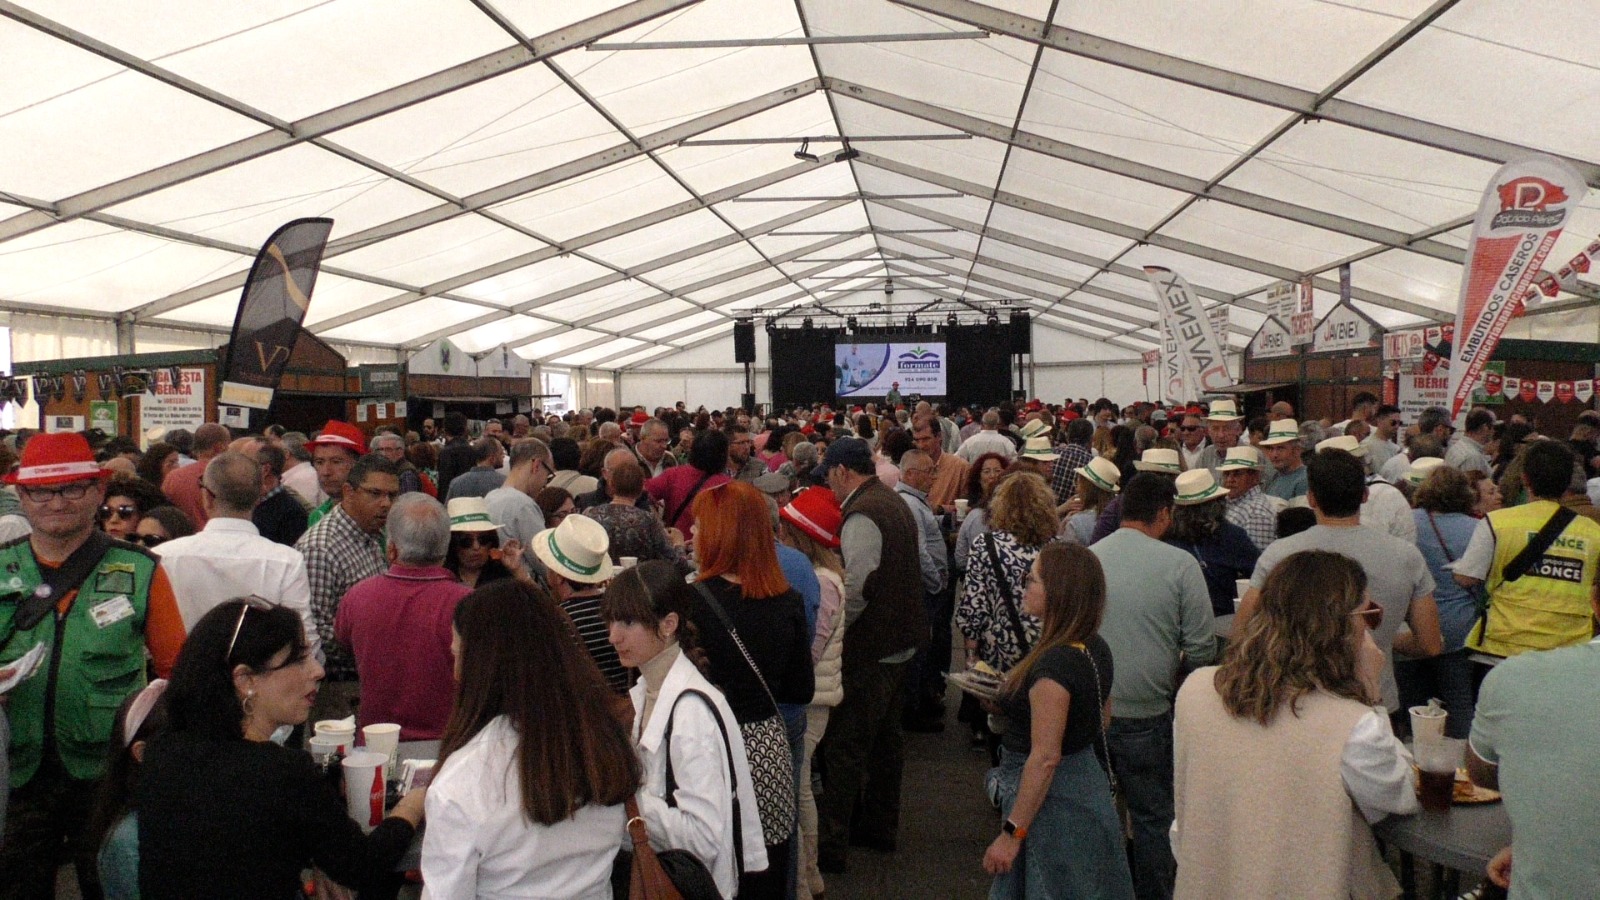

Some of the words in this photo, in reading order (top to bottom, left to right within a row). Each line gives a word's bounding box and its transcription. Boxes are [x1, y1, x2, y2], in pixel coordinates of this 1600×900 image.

[1496, 213, 1530, 225] Patricio
[1461, 294, 1505, 363] EMBUTIDOS
[1500, 232, 1539, 291] CASEROS
[1160, 275, 1227, 391] JAVENEX
[1324, 319, 1359, 342] JAVENEX
[900, 361, 938, 369] formate
[1556, 537, 1585, 550] NCE
[1540, 565, 1582, 580] ONCE
